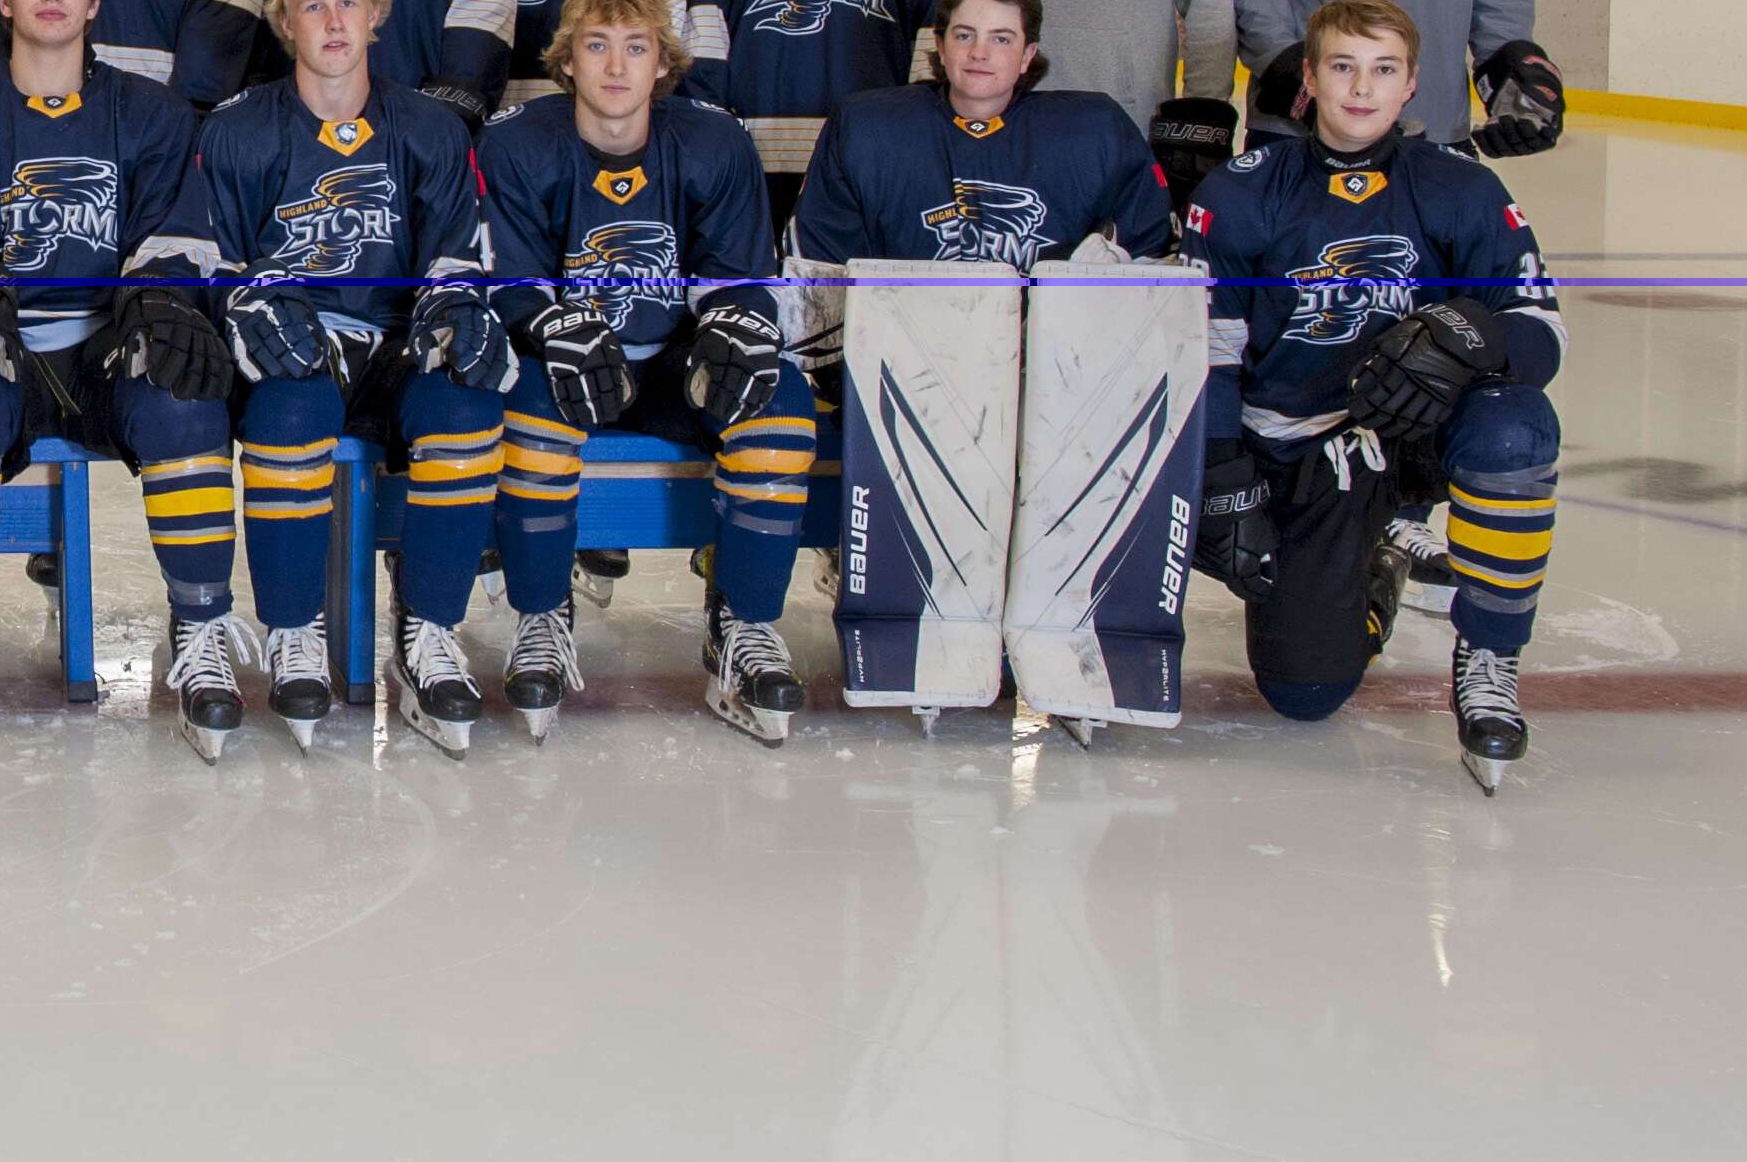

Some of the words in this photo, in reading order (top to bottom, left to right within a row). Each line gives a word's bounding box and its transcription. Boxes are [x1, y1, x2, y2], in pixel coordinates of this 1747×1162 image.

[1154, 122, 1230, 144] AUER
[279, 198, 329, 220] HIGHLAND
[927, 208, 957, 225] HIGHL
[286, 206, 394, 246] STOR
[542, 310, 608, 339] BAU
[698, 310, 781, 341] AUER
[850, 486, 870, 595] BAUER
[1159, 494, 1190, 616] BAUER
